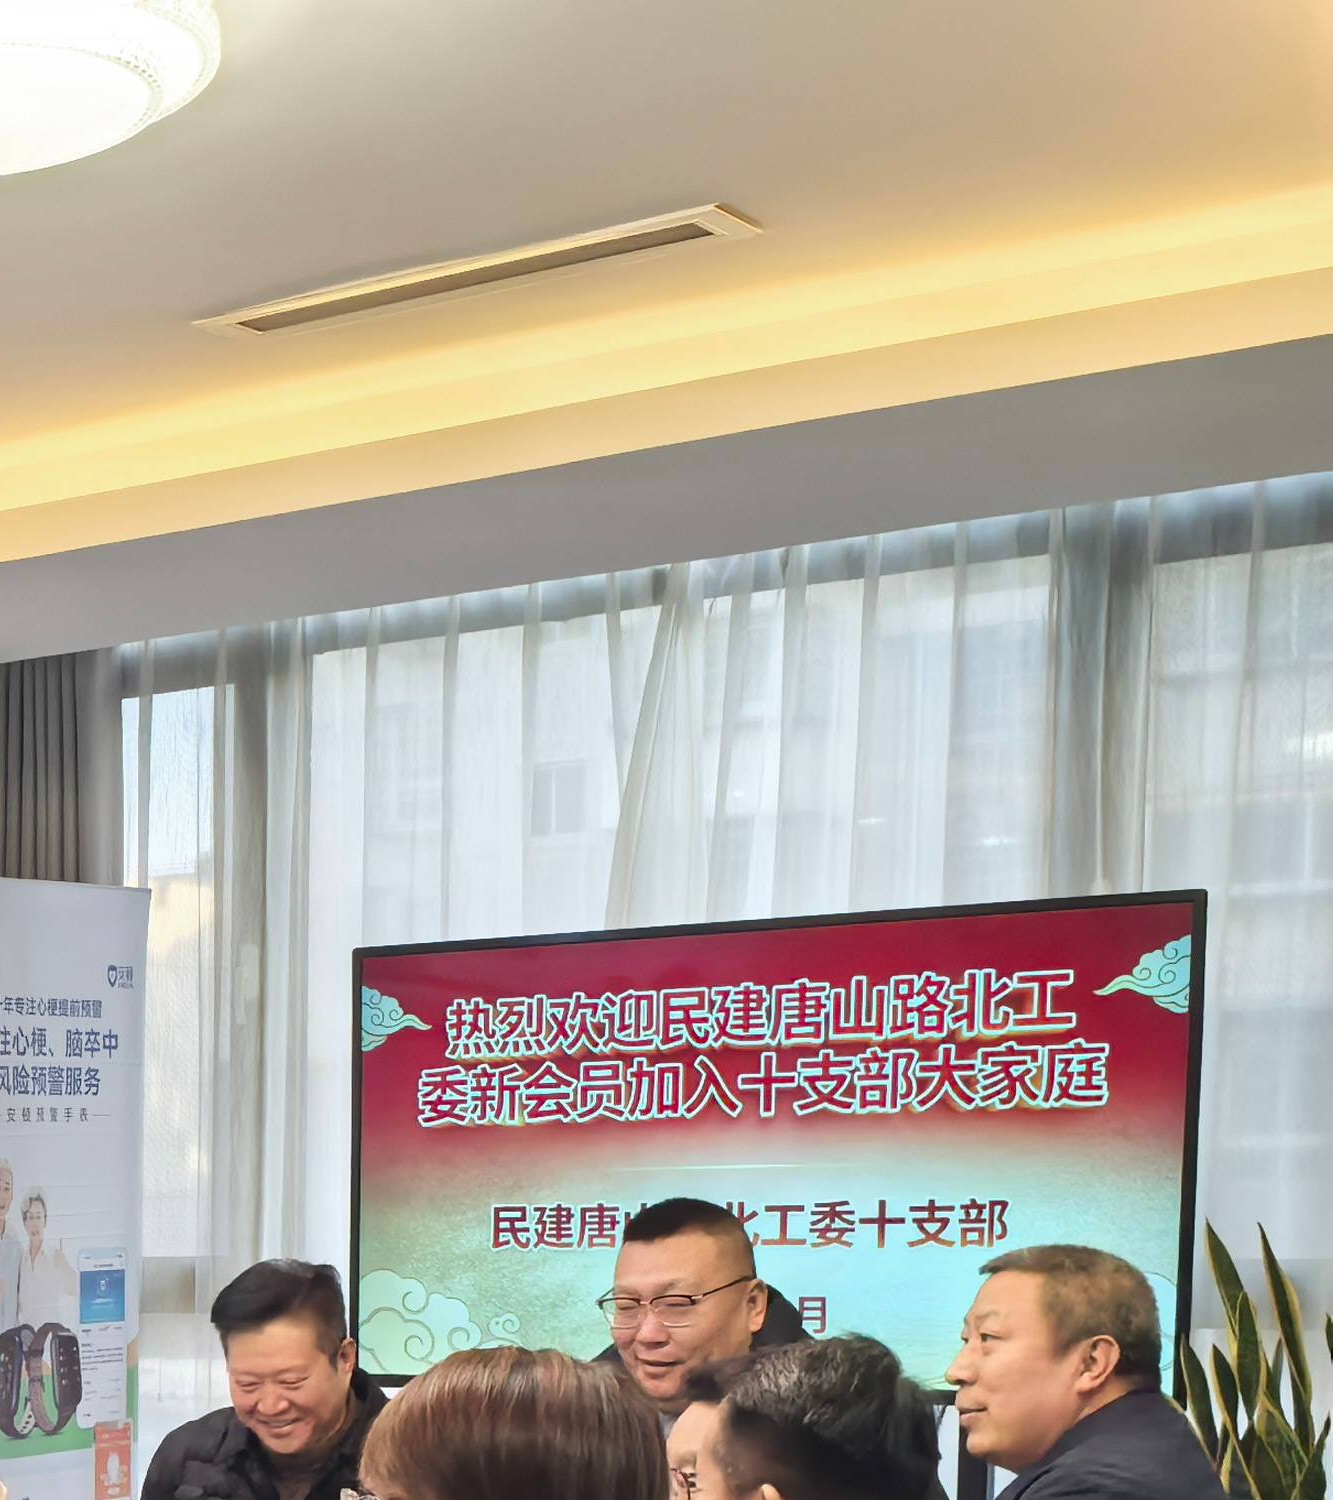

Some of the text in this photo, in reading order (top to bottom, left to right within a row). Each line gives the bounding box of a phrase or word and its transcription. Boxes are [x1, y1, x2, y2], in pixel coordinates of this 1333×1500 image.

[445, 968, 1077, 1059] 热烈欢迎民建唐山路北工
[417, 1042, 1110, 1128] 委新会员加入十支部大家庭
[491, 1199, 1010, 1250] 民建唐工委十支部
